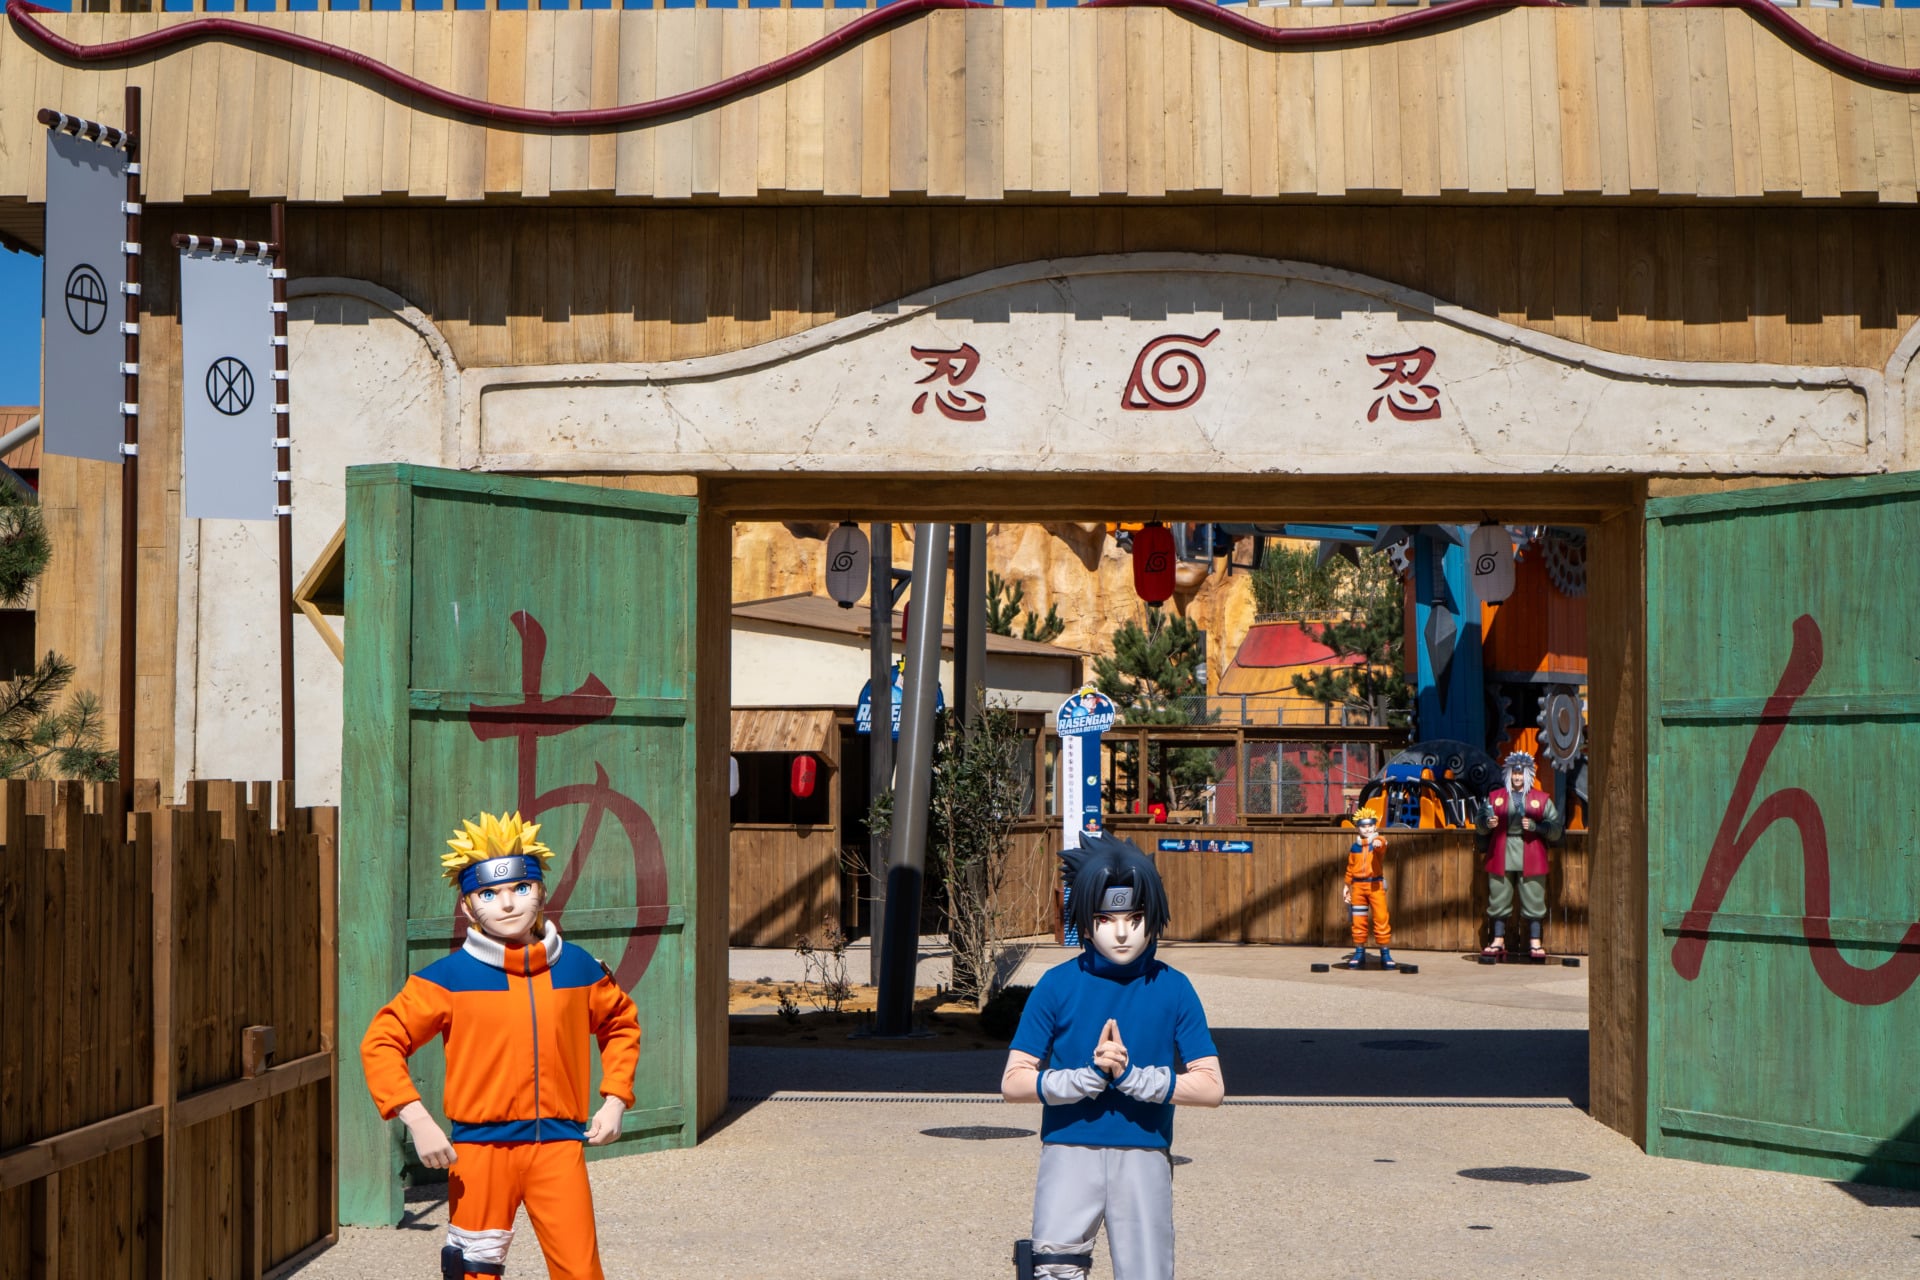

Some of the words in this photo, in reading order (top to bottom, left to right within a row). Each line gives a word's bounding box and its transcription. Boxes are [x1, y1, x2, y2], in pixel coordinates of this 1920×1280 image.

[911, 343, 987, 422] 忍
[1366, 346, 1442, 422] 忍
[1059, 713, 1114, 730] RASENGAN
